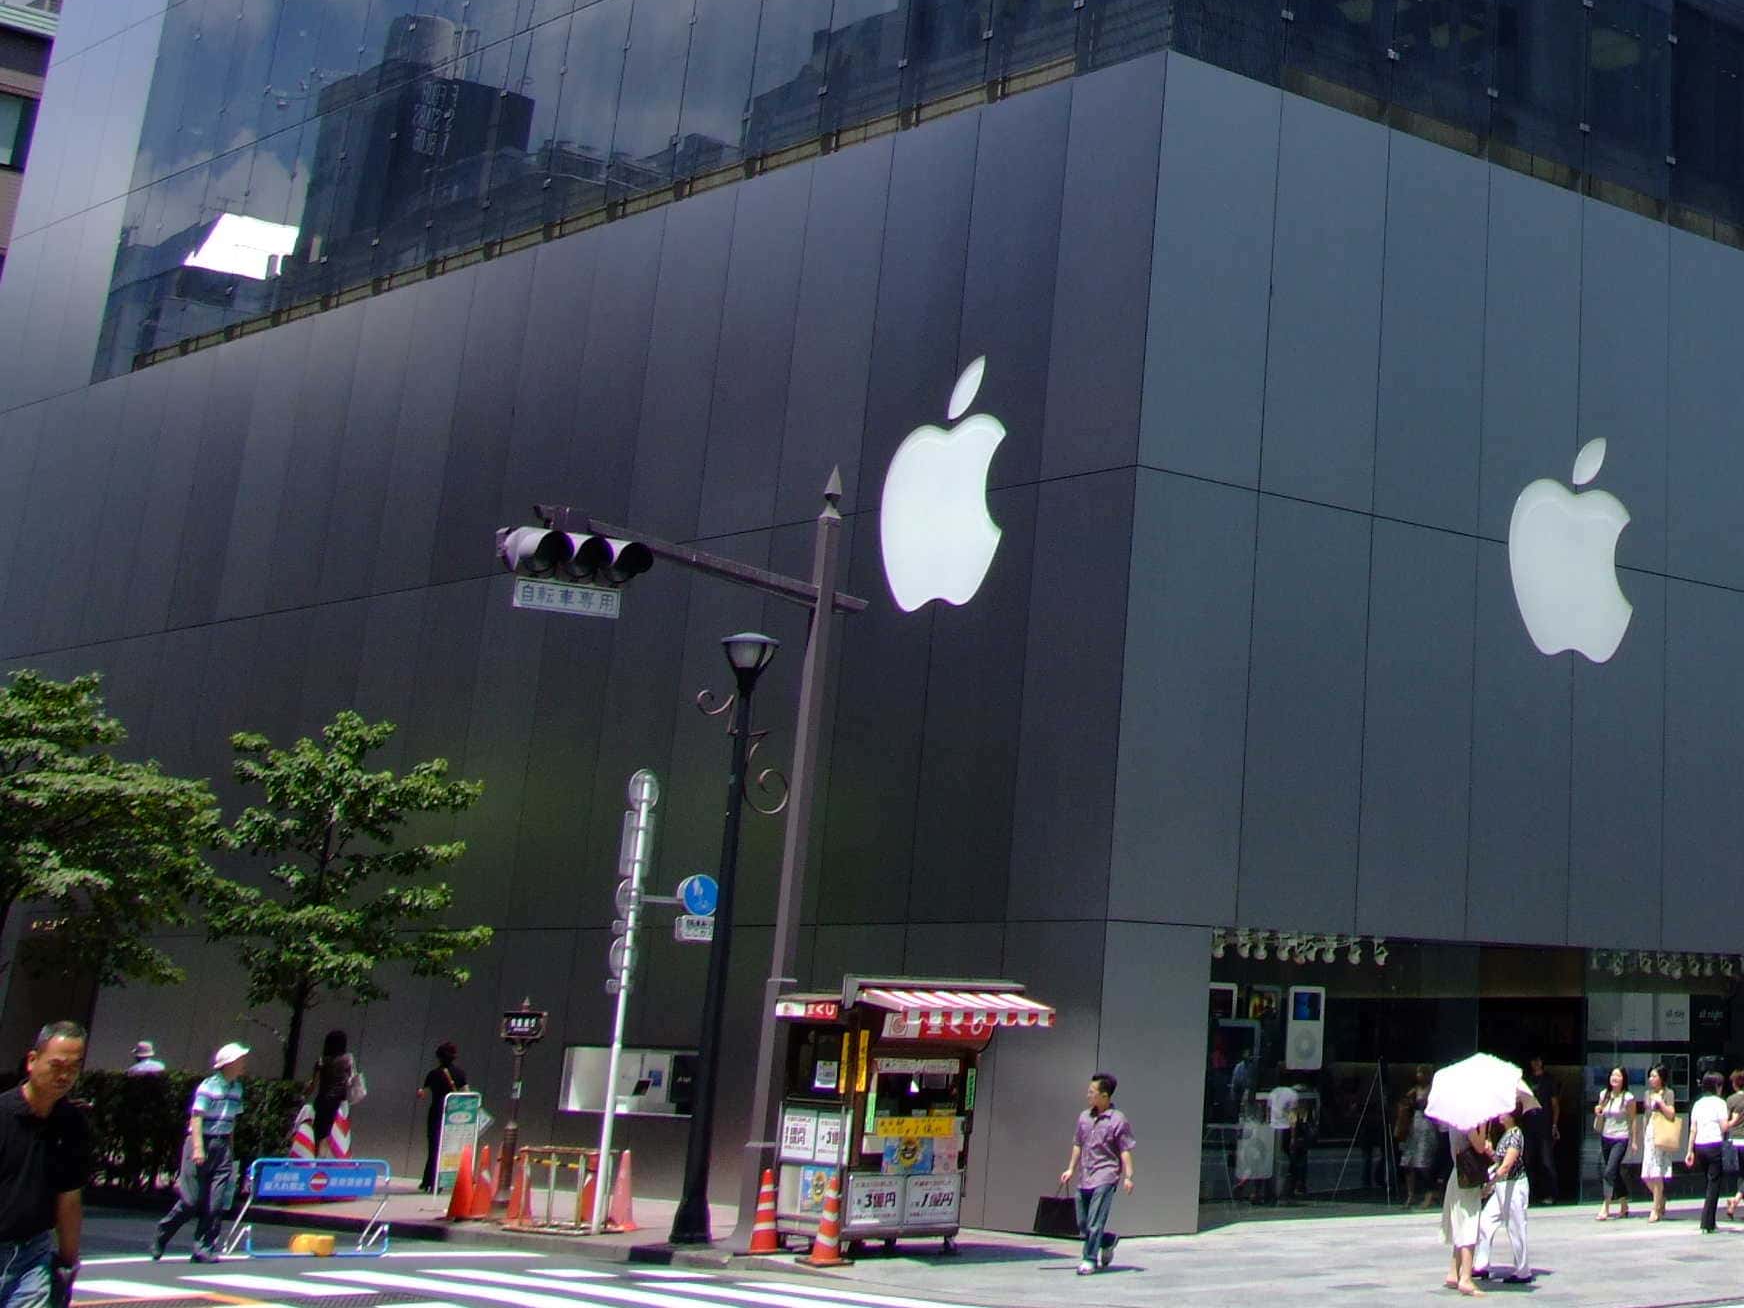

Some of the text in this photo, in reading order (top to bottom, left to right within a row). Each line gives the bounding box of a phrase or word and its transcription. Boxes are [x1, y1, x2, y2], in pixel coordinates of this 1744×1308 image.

[521, 584, 615, 612] 自転車専用
